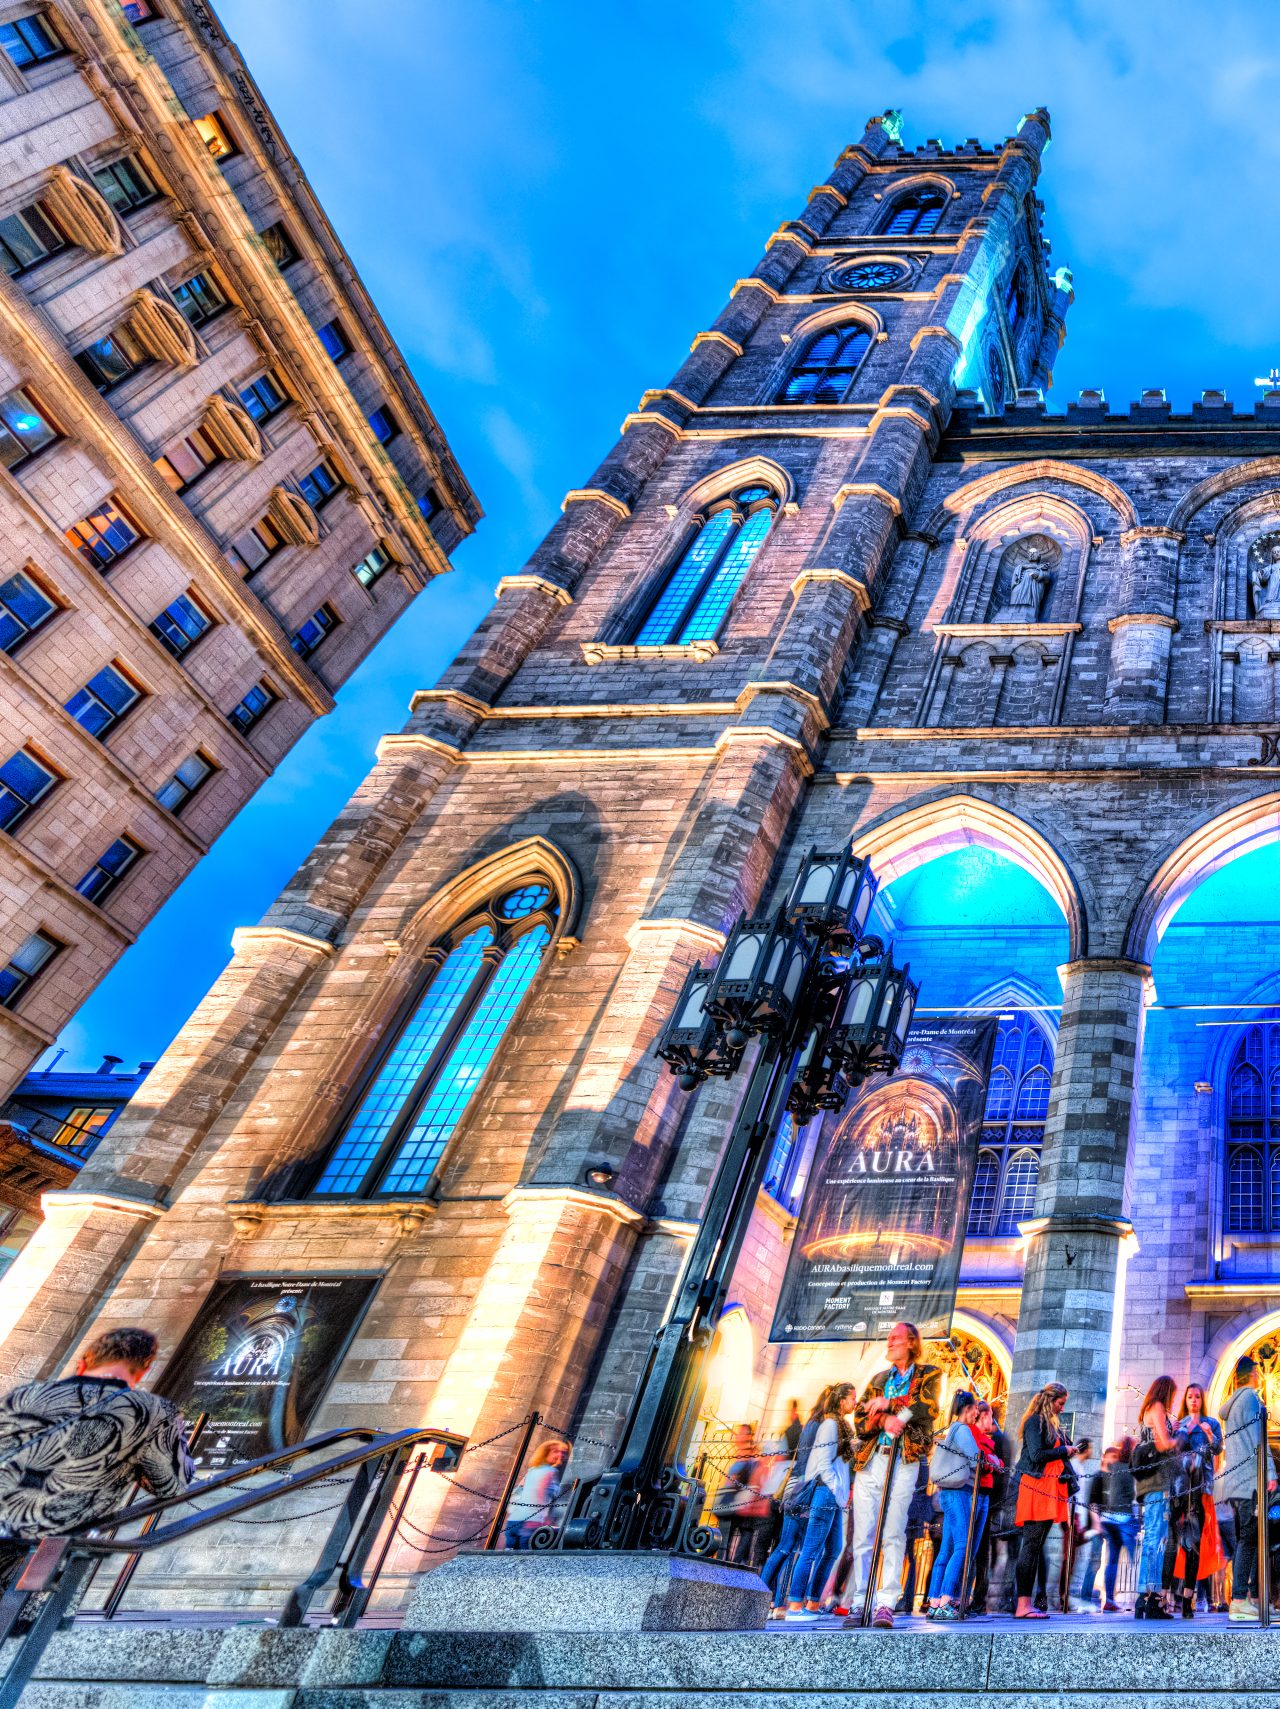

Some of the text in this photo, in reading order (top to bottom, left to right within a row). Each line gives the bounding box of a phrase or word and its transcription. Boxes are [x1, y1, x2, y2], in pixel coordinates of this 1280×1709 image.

[848, 1150, 935, 1173] AURA
[811, 1263, 934, 1274] AURAbasiliquemontreal.com
[213, 1357, 280, 1376] AURA
